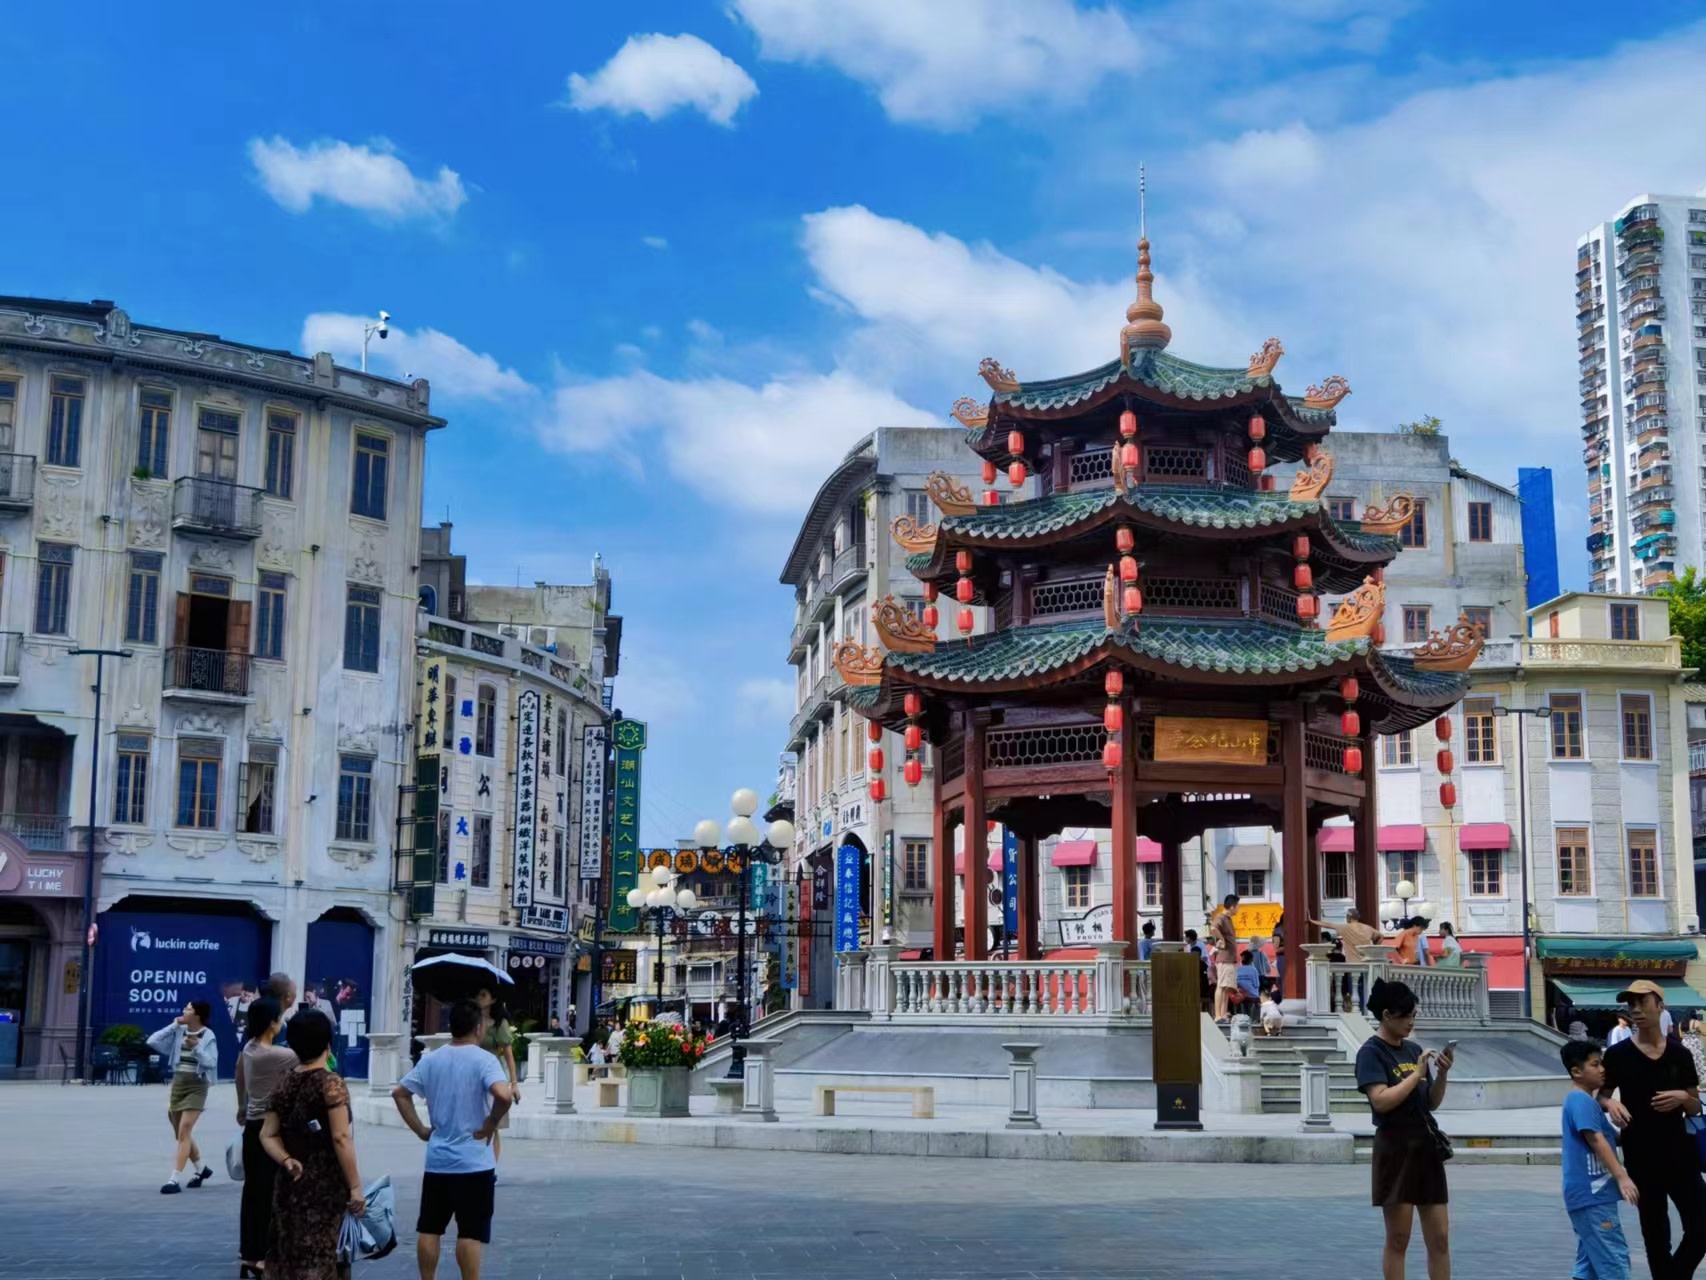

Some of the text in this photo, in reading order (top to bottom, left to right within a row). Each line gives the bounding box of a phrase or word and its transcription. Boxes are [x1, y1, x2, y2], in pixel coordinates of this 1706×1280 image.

[28, 880, 62, 891] TIME
[155, 938, 220, 951] luckin coffee
[131, 969, 207, 984] OPENING
[129, 988, 178, 1003] SOON
